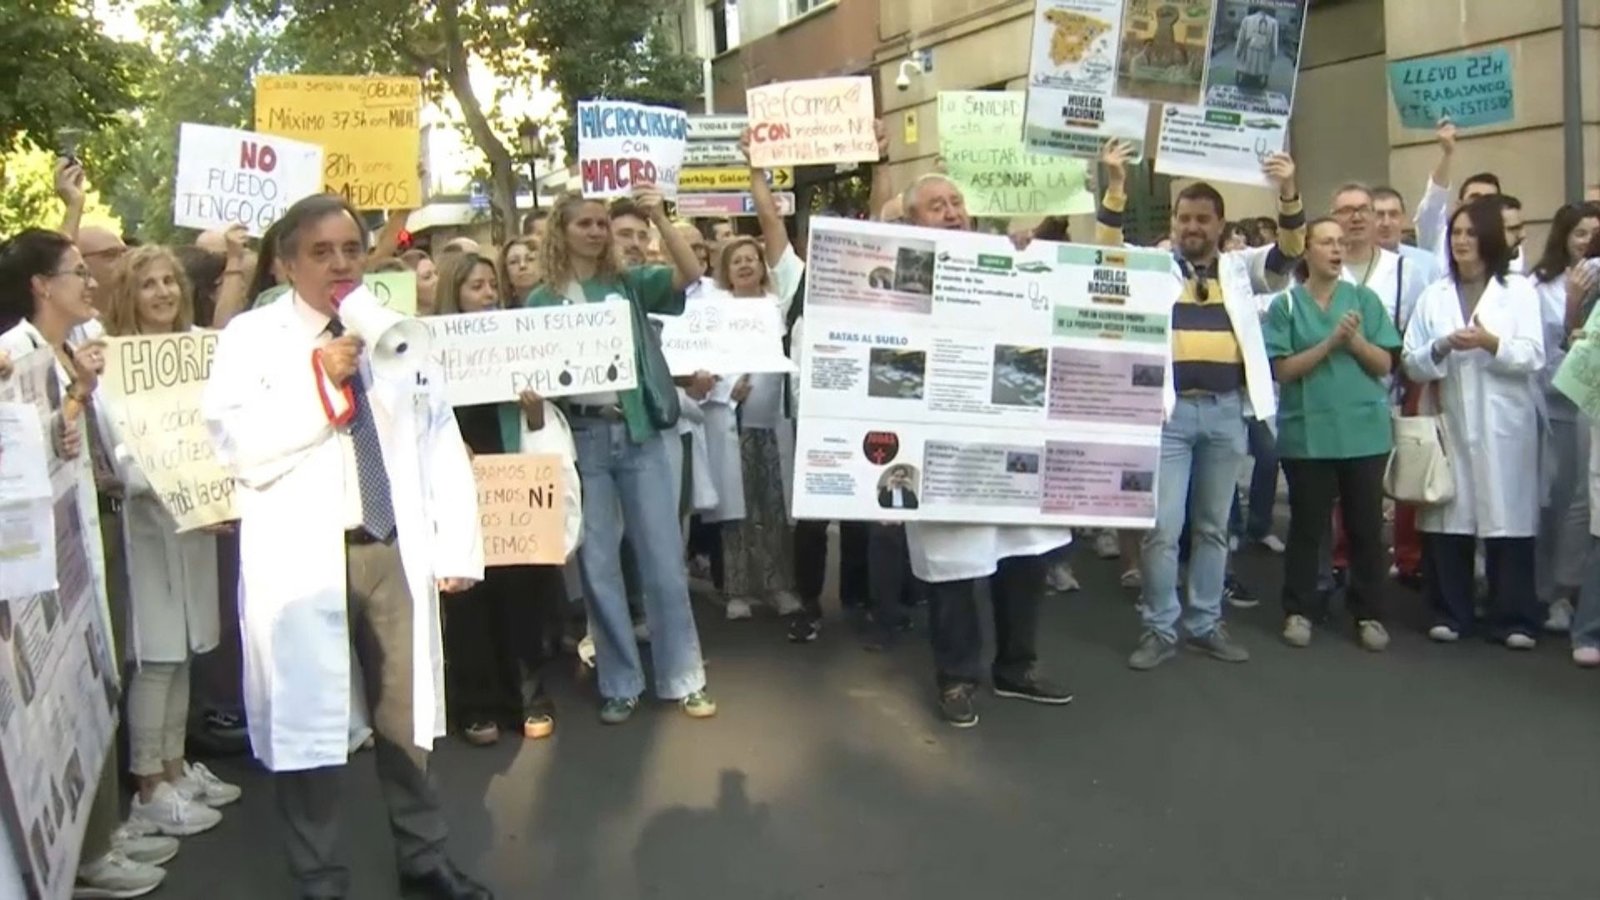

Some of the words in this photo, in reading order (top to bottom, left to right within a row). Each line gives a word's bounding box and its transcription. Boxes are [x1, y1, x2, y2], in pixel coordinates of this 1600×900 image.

[1403, 65, 1457, 84] LLEVO
[1068, 95, 1103, 109] HUELGA
[1061, 106, 1105, 122] NACIONAL
[752, 122, 790, 143] CON
[240, 140, 277, 172] NO
[581, 158, 657, 193] MACRO
[970, 171, 1035, 188] ASESINAR
[1046, 172, 1068, 187] LA
[183, 193, 253, 225] TENGO
[977, 189, 1048, 213] SALUD
[1095, 249, 1103, 265] 3
[1093, 269, 1127, 282] HUELGA
[1088, 282, 1131, 297] NACIONAL
[515, 318, 536, 332] NI
[544, 310, 616, 329] ESCLAVOS
[875, 335, 909, 346] SUELO
[529, 483, 554, 509] Ni
[510, 512, 532, 527] LO
